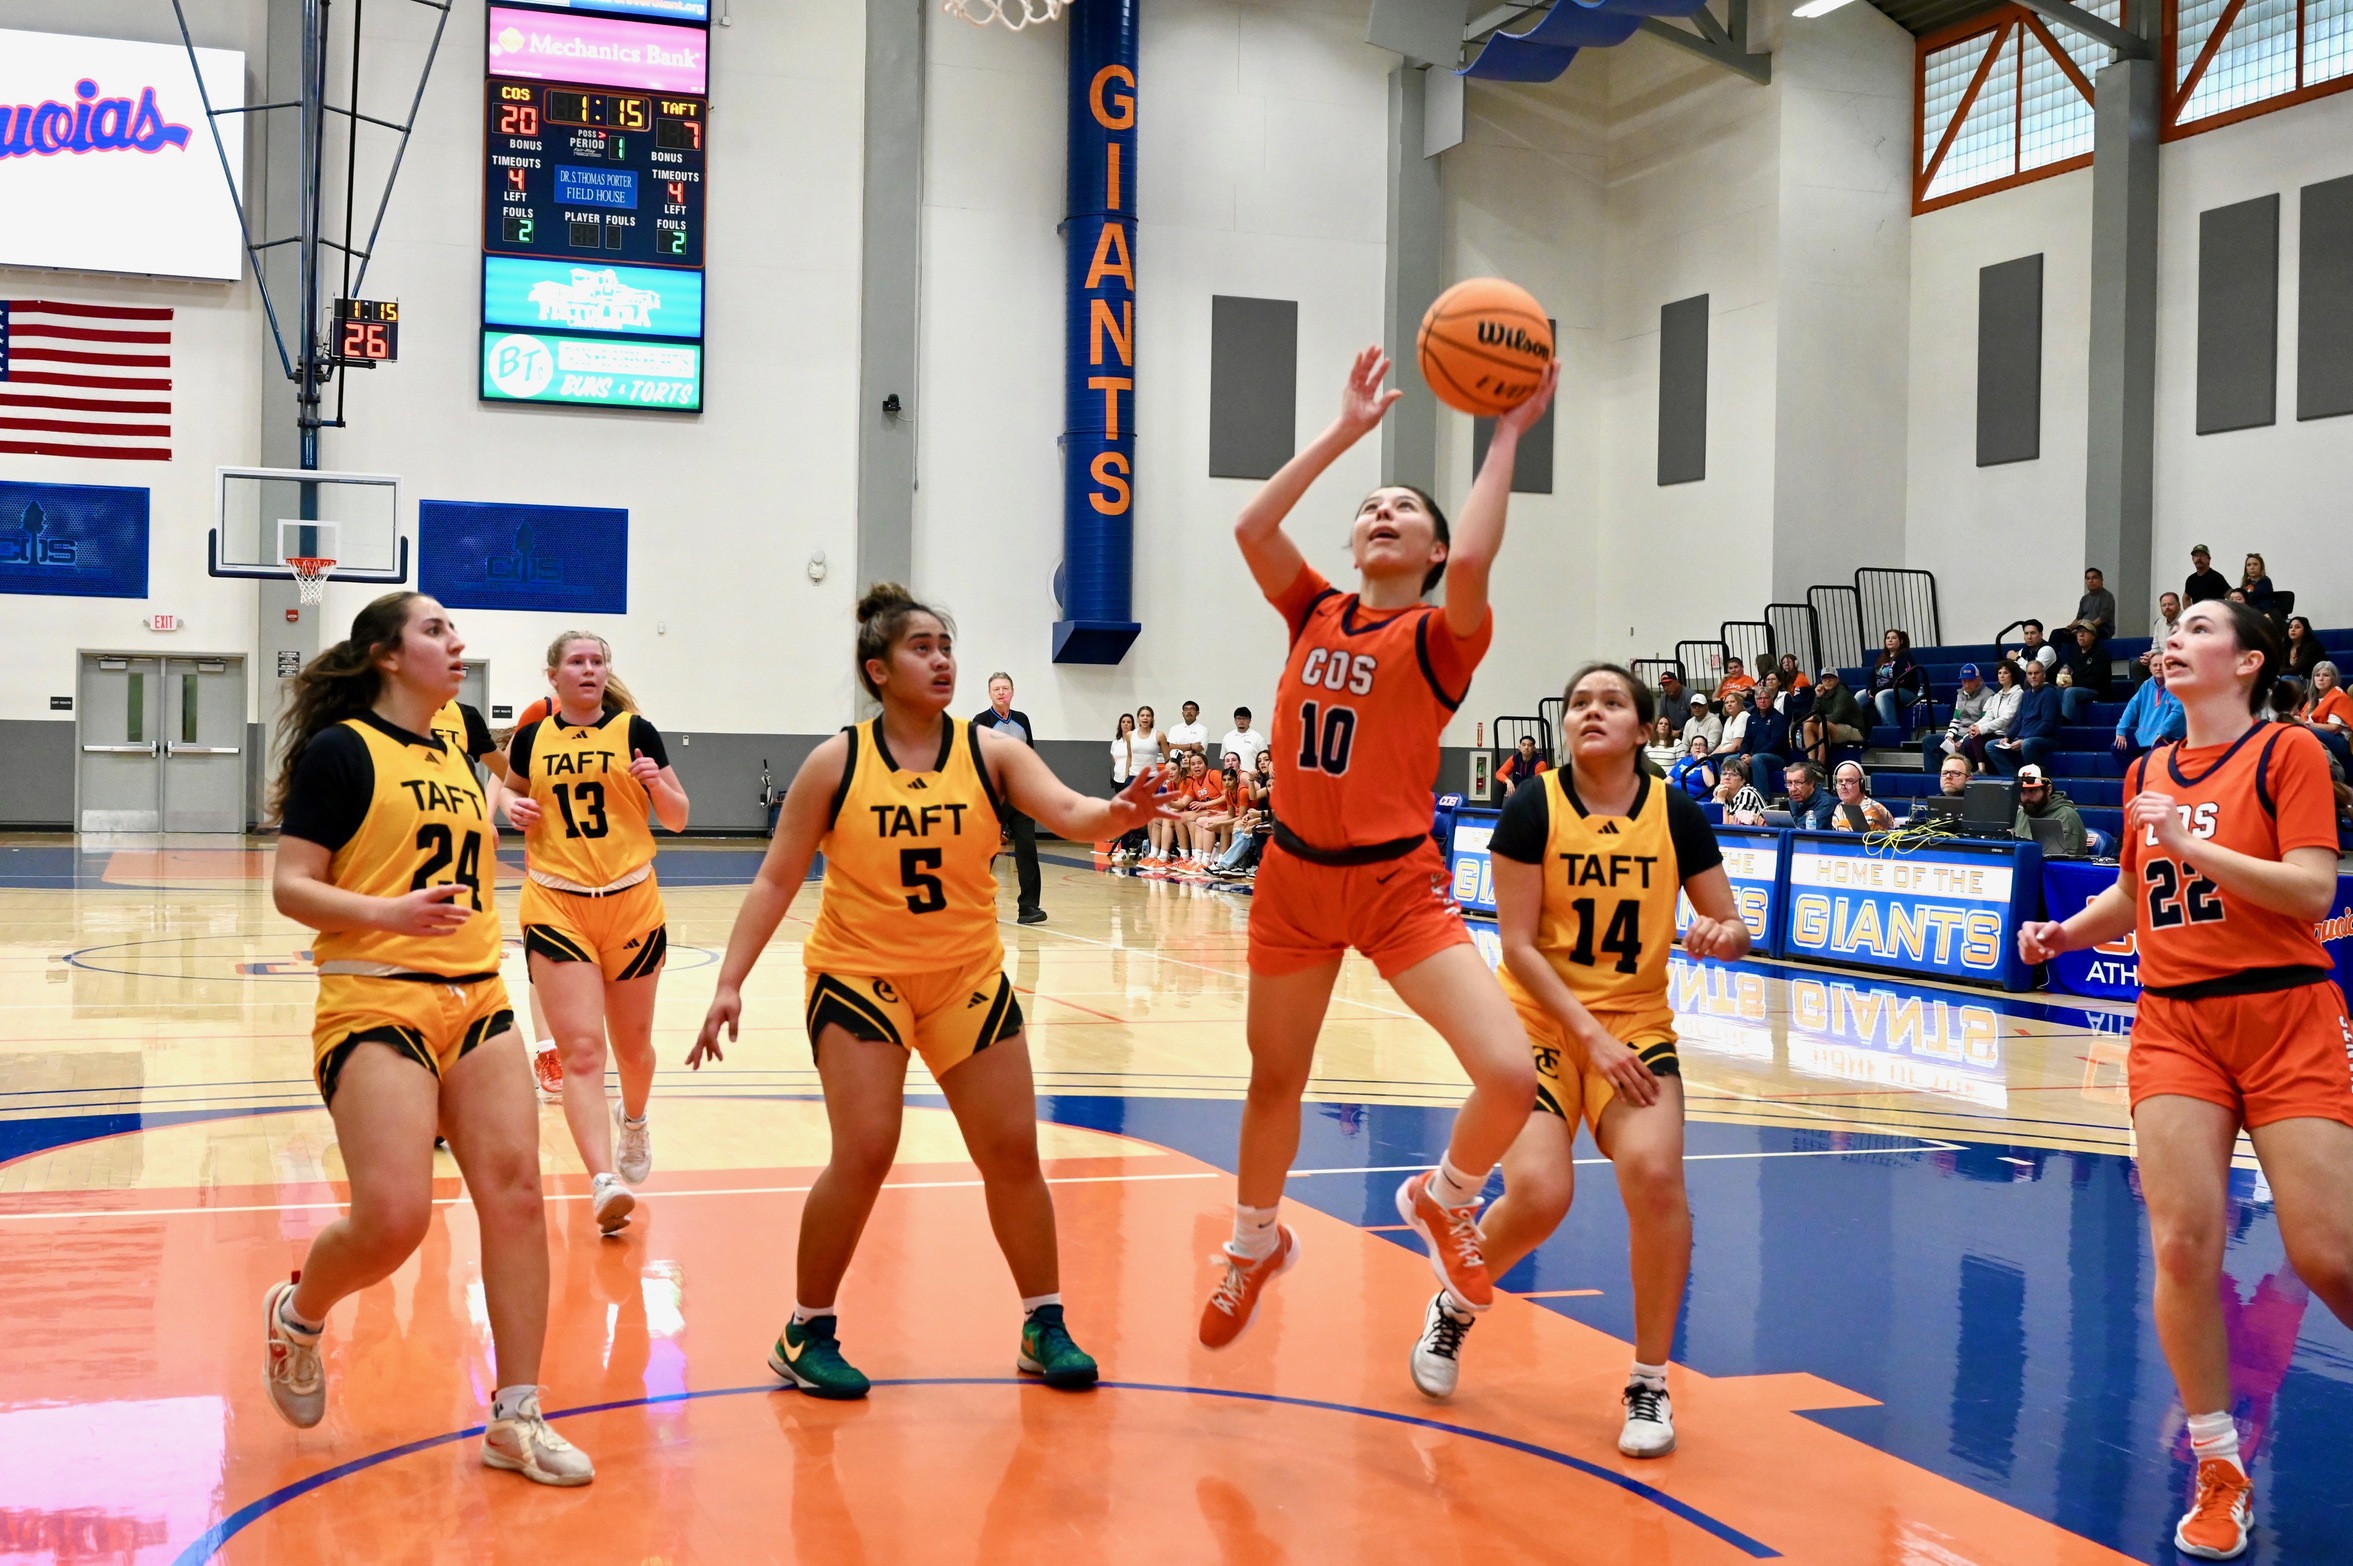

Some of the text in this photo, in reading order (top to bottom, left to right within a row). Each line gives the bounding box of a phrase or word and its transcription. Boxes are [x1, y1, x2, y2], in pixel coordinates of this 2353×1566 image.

[529, 32, 697, 68] Mechanics Bank
[502, 86, 530, 100] COS
[501, 105, 536, 135] 20
[661, 101, 697, 116] TAFT
[510, 139, 542, 151] BONUS
[570, 137, 605, 149] PERIOD
[578, 129, 597, 138] POSS
[683, 122, 699, 149] 7
[618, 138, 624, 159] 1
[651, 151, 683, 163] BONUS
[492, 155, 541, 169] TIMEOUTS
[509, 169, 523, 190] 4
[577, 172, 605, 185] THOMAS
[607, 174, 632, 188] PORTER
[652, 169, 700, 182] TIMEOUTS
[504, 191, 527, 202] LEFT
[567, 187, 625, 203] FIELD HOUSE
[669, 182, 682, 203] 4
[503, 206, 533, 218] FOULS
[565, 211, 636, 226] PLAYER FOULS
[664, 204, 687, 215] LEFT
[518, 219, 532, 242] 2
[657, 219, 686, 230] FOULS
[672, 231, 685, 253] 2
[1084, 64, 1135, 516] GIANTS
[344, 323, 386, 358] 26
[1478, 321, 1549, 361] Wilson
[560, 374, 613, 397] BUNS
[629, 380, 693, 405] TORTS
[155, 615, 173, 628] EXIT
[1301, 647, 1378, 696] COS
[1297, 699, 1357, 778] 10
[542, 751, 615, 776] TAFT
[400, 780, 482, 820] TAFT
[552, 781, 608, 839] 13
[870, 804, 968, 838] TAFT
[410, 823, 483, 912] 24
[1559, 853, 1657, 889] TAFT
[1816, 859, 1984, 895] HOME OF THE
[899, 847, 947, 914] 5
[2144, 856, 2227, 931] 22
[1569, 898, 1643, 975] 14
[1793, 893, 2002, 970] GIANTS
